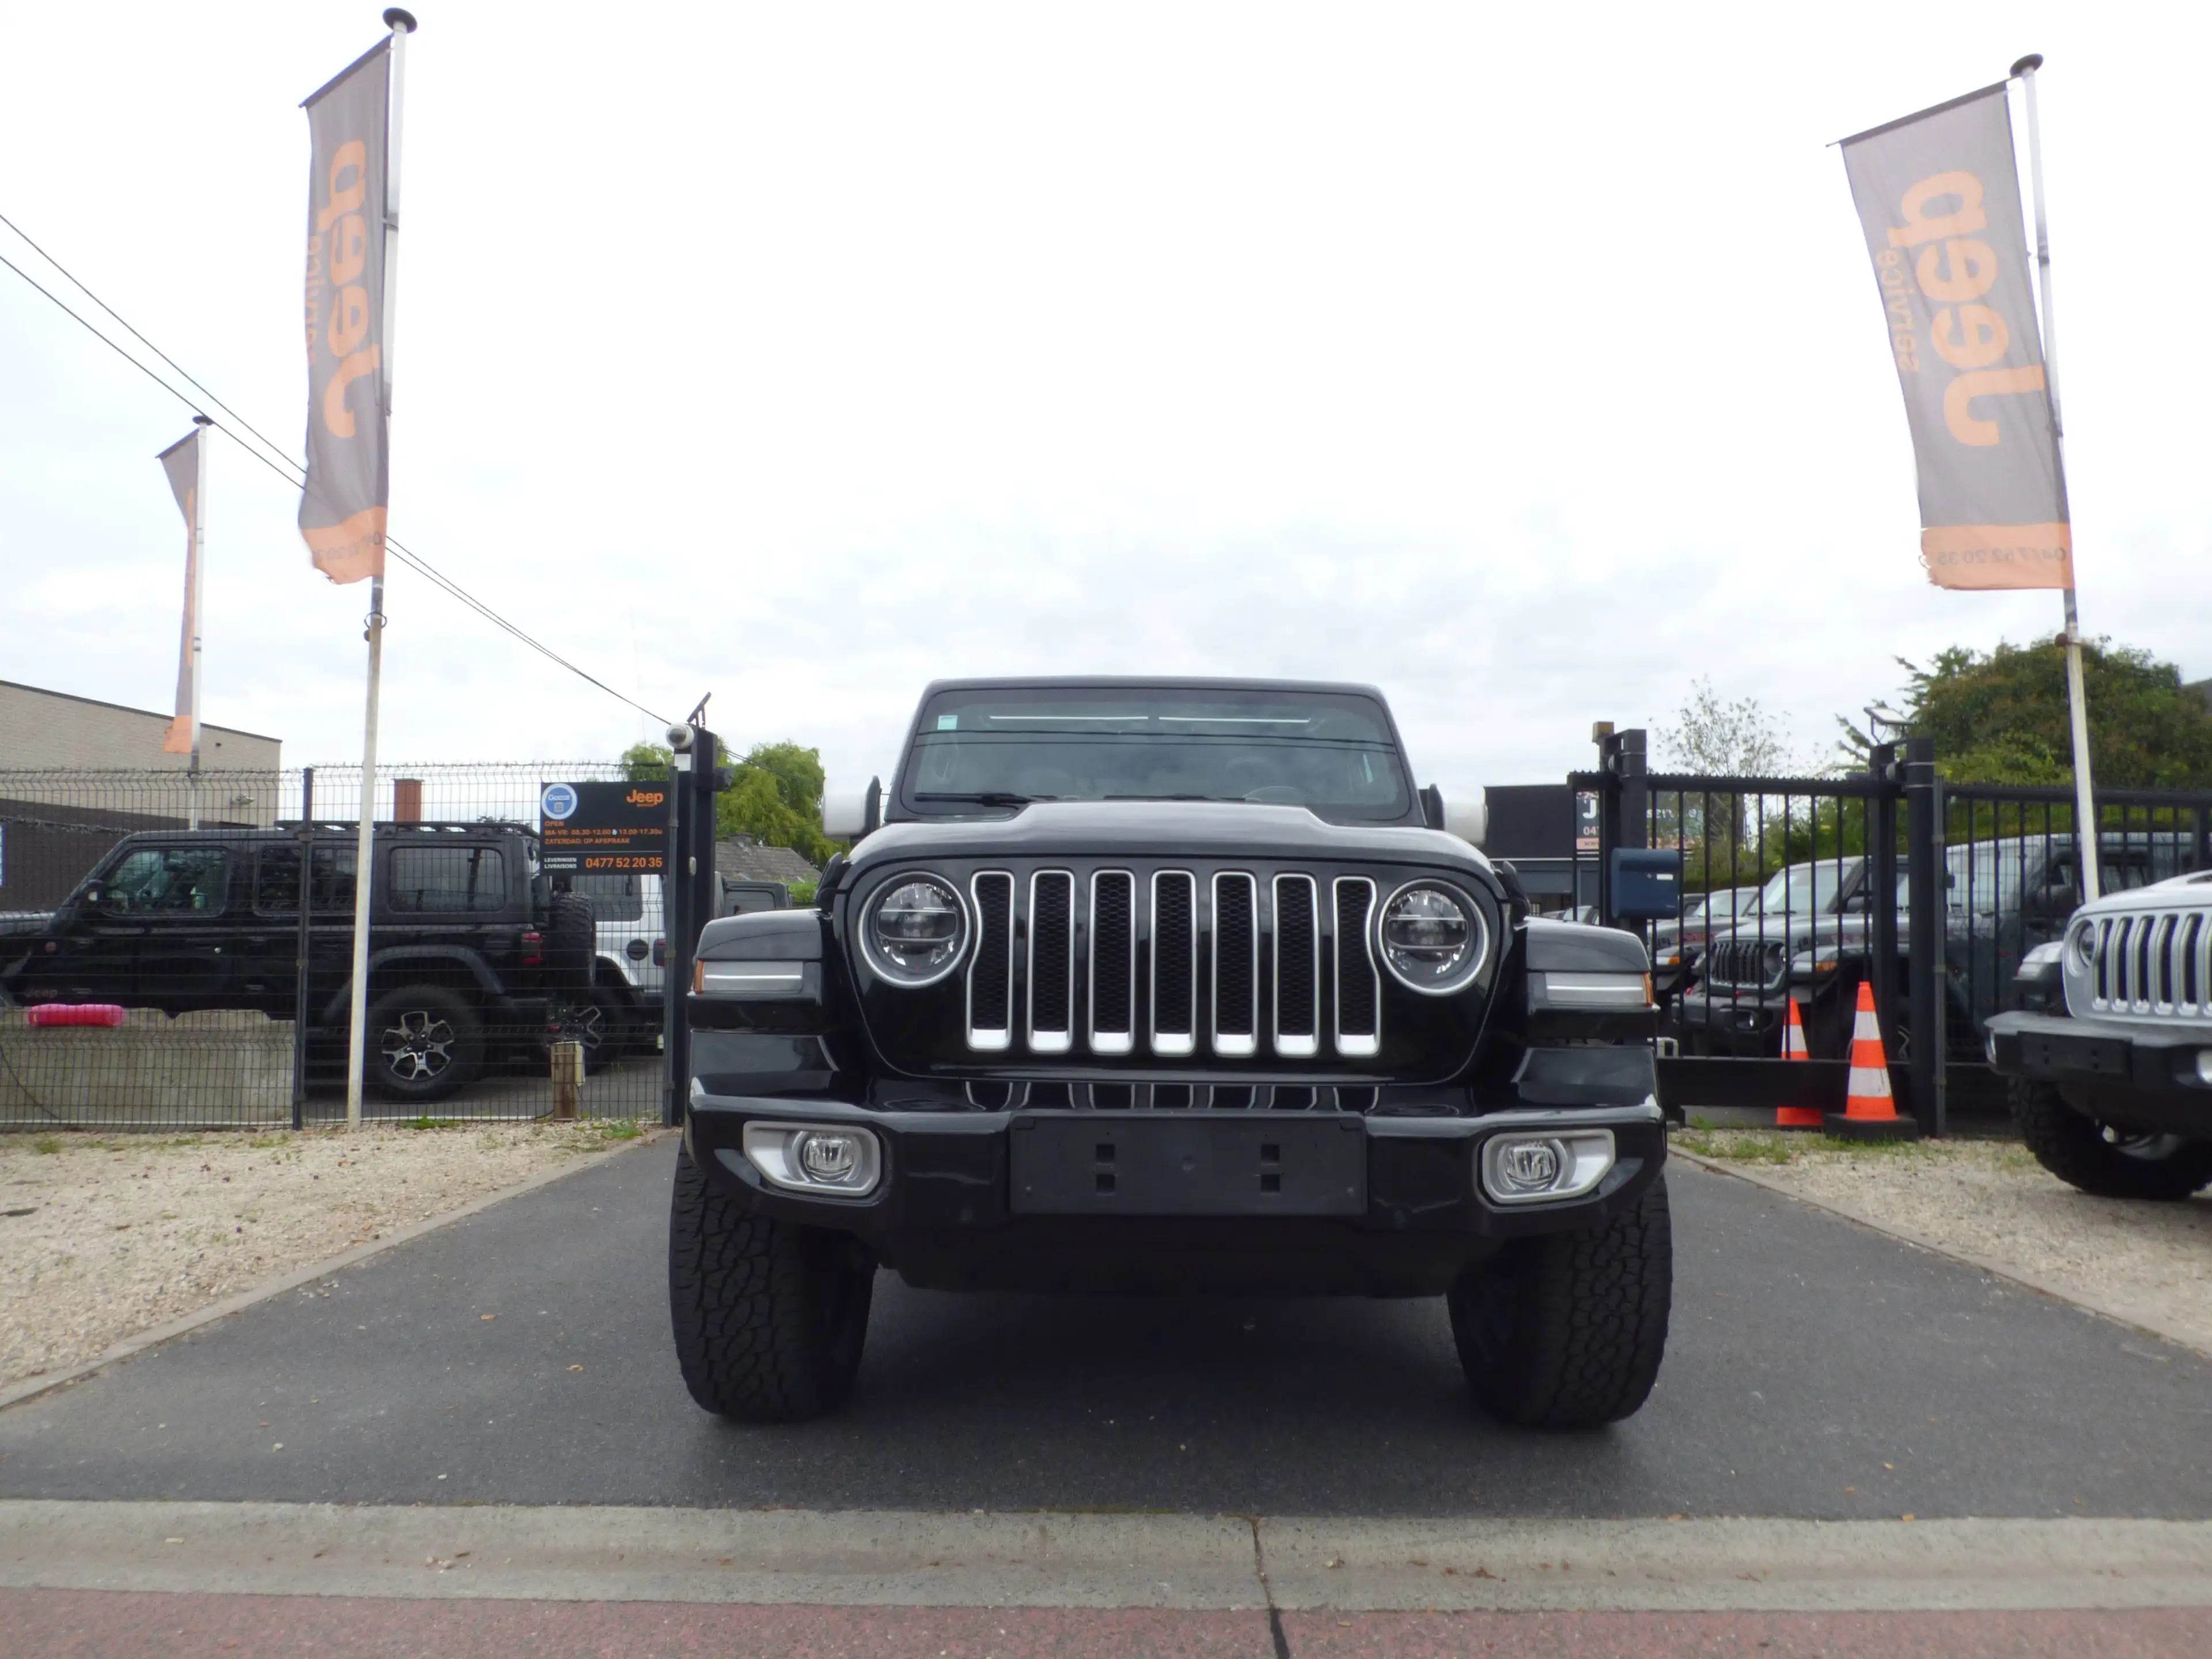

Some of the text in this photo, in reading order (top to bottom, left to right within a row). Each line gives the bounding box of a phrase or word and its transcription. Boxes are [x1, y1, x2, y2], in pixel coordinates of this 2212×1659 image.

[626, 790, 664, 805] Jeep
[1582, 799, 1599, 819] J
[585, 857, 662, 868] 0477 52 20 35
